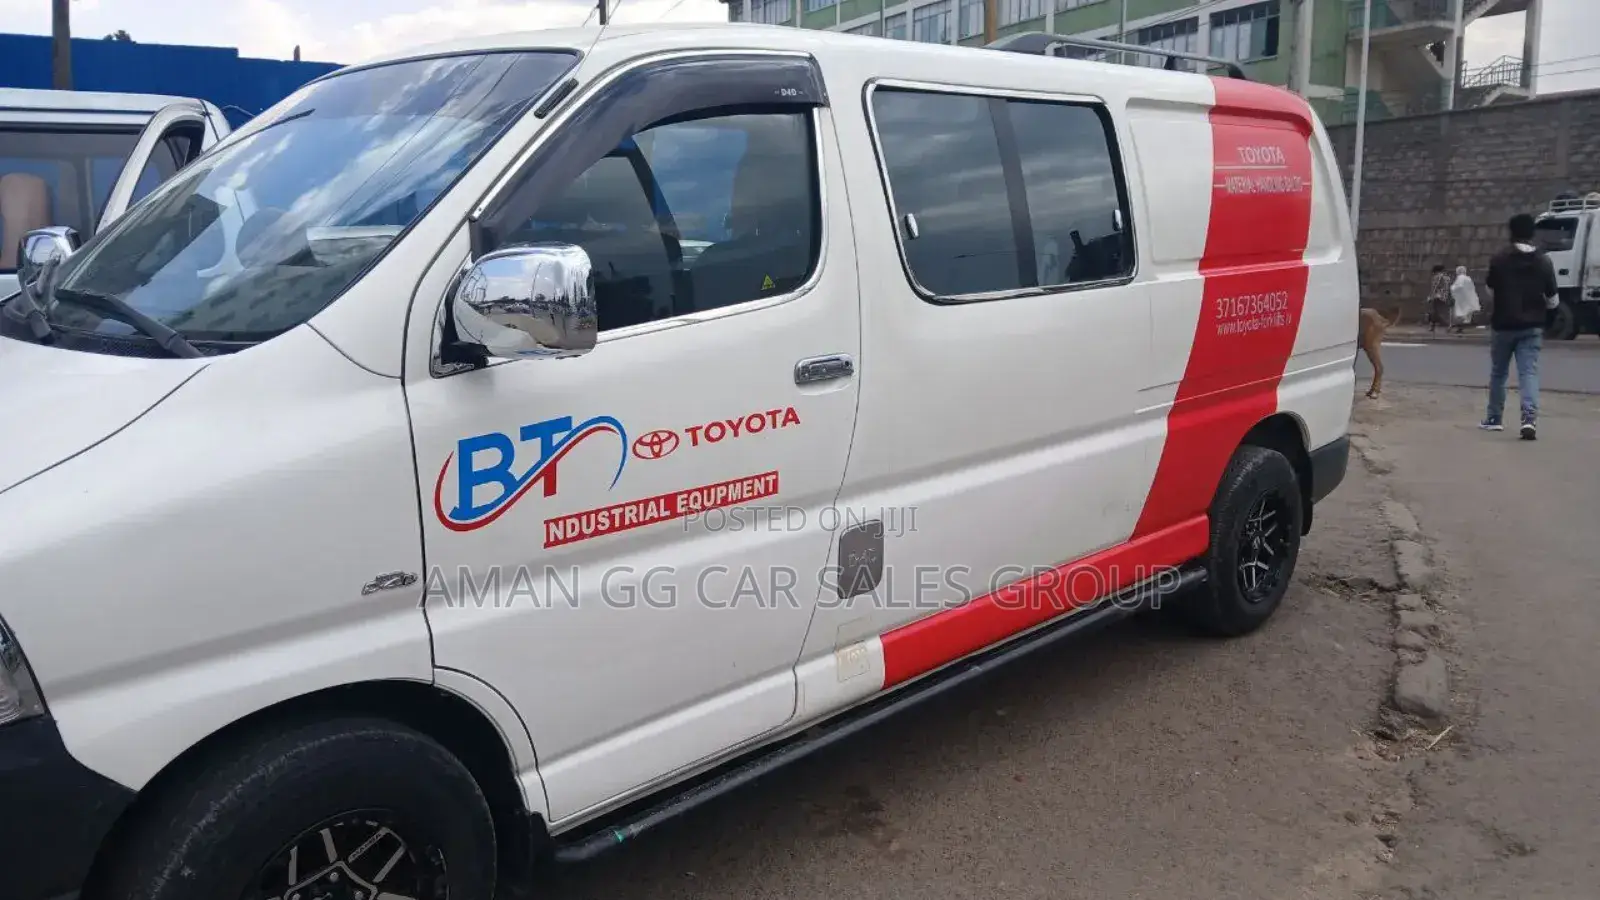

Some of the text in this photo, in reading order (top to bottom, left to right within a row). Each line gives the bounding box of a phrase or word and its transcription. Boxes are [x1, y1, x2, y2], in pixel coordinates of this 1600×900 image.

[1237, 146, 1285, 164] TOYOTA
[1215, 291, 1288, 319] 37167364052
[685, 407, 800, 447] TOYOTA
[449, 416, 572, 520] BT
[676, 474, 777, 513] EQUPMENT
